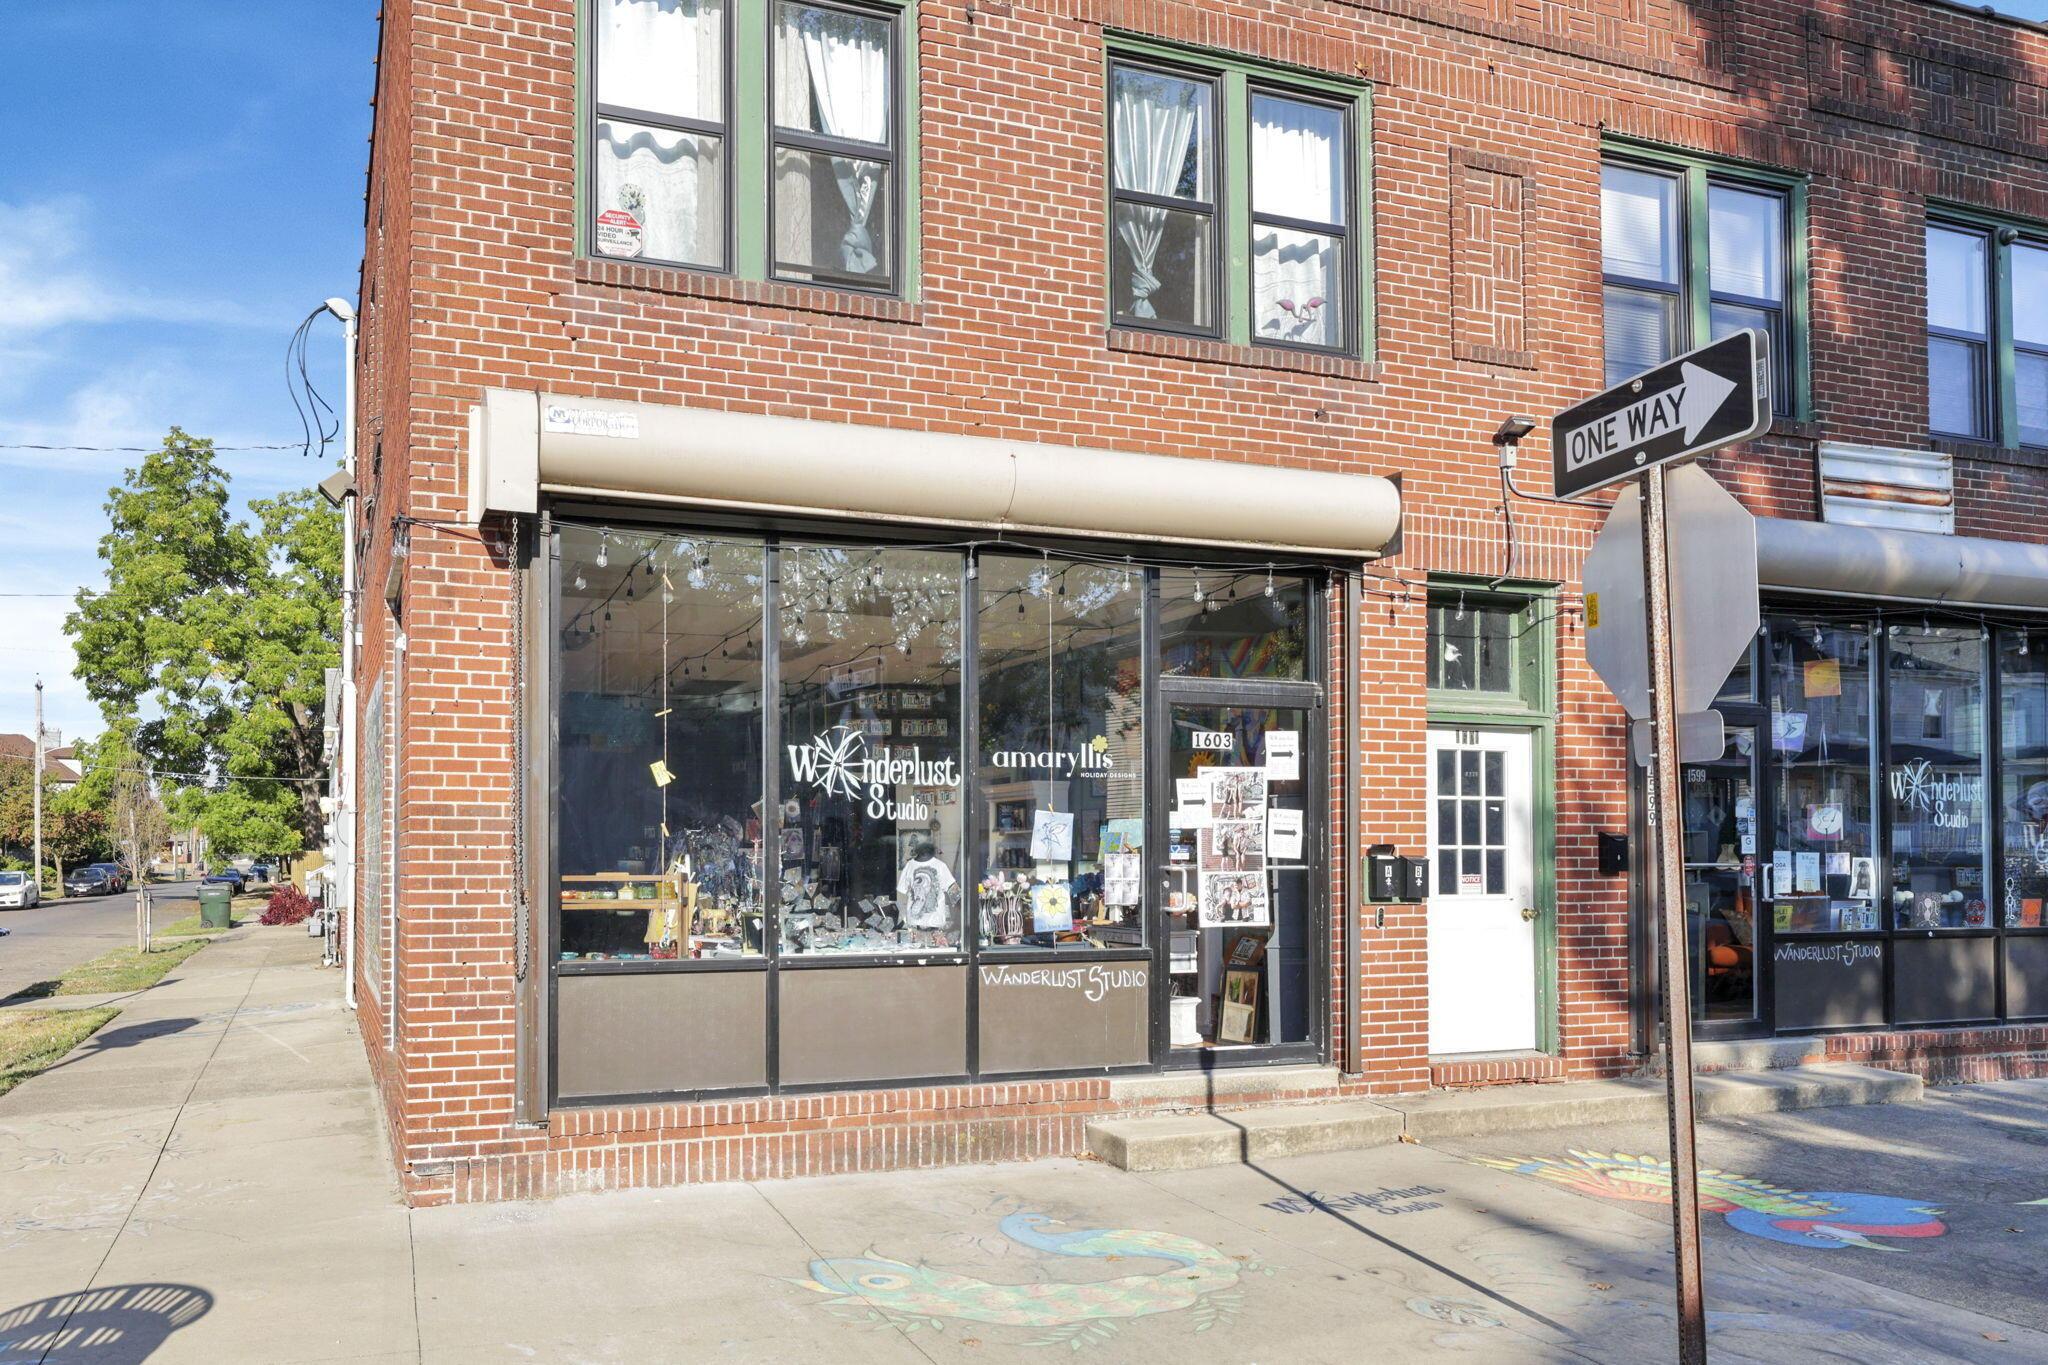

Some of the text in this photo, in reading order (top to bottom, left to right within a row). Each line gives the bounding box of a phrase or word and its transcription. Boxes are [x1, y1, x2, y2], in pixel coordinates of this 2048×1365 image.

[605, 212, 631, 221] SECURITY
[606, 226, 624, 234] HOUR
[1572, 387, 1687, 464] ONE WAY
[1195, 733, 1232, 748] 1603
[992, 742, 1114, 777] amaryllis
[1080, 771, 1137, 779] HOLIDAY DESIGNS
[1688, 768, 1707, 783] 1599
[867, 784, 928, 820] Studio
[1934, 801, 1969, 828] Studio
[1460, 875, 1481, 884] NOTICE
[979, 965, 1147, 1001] WANDERLUST STUDIO
